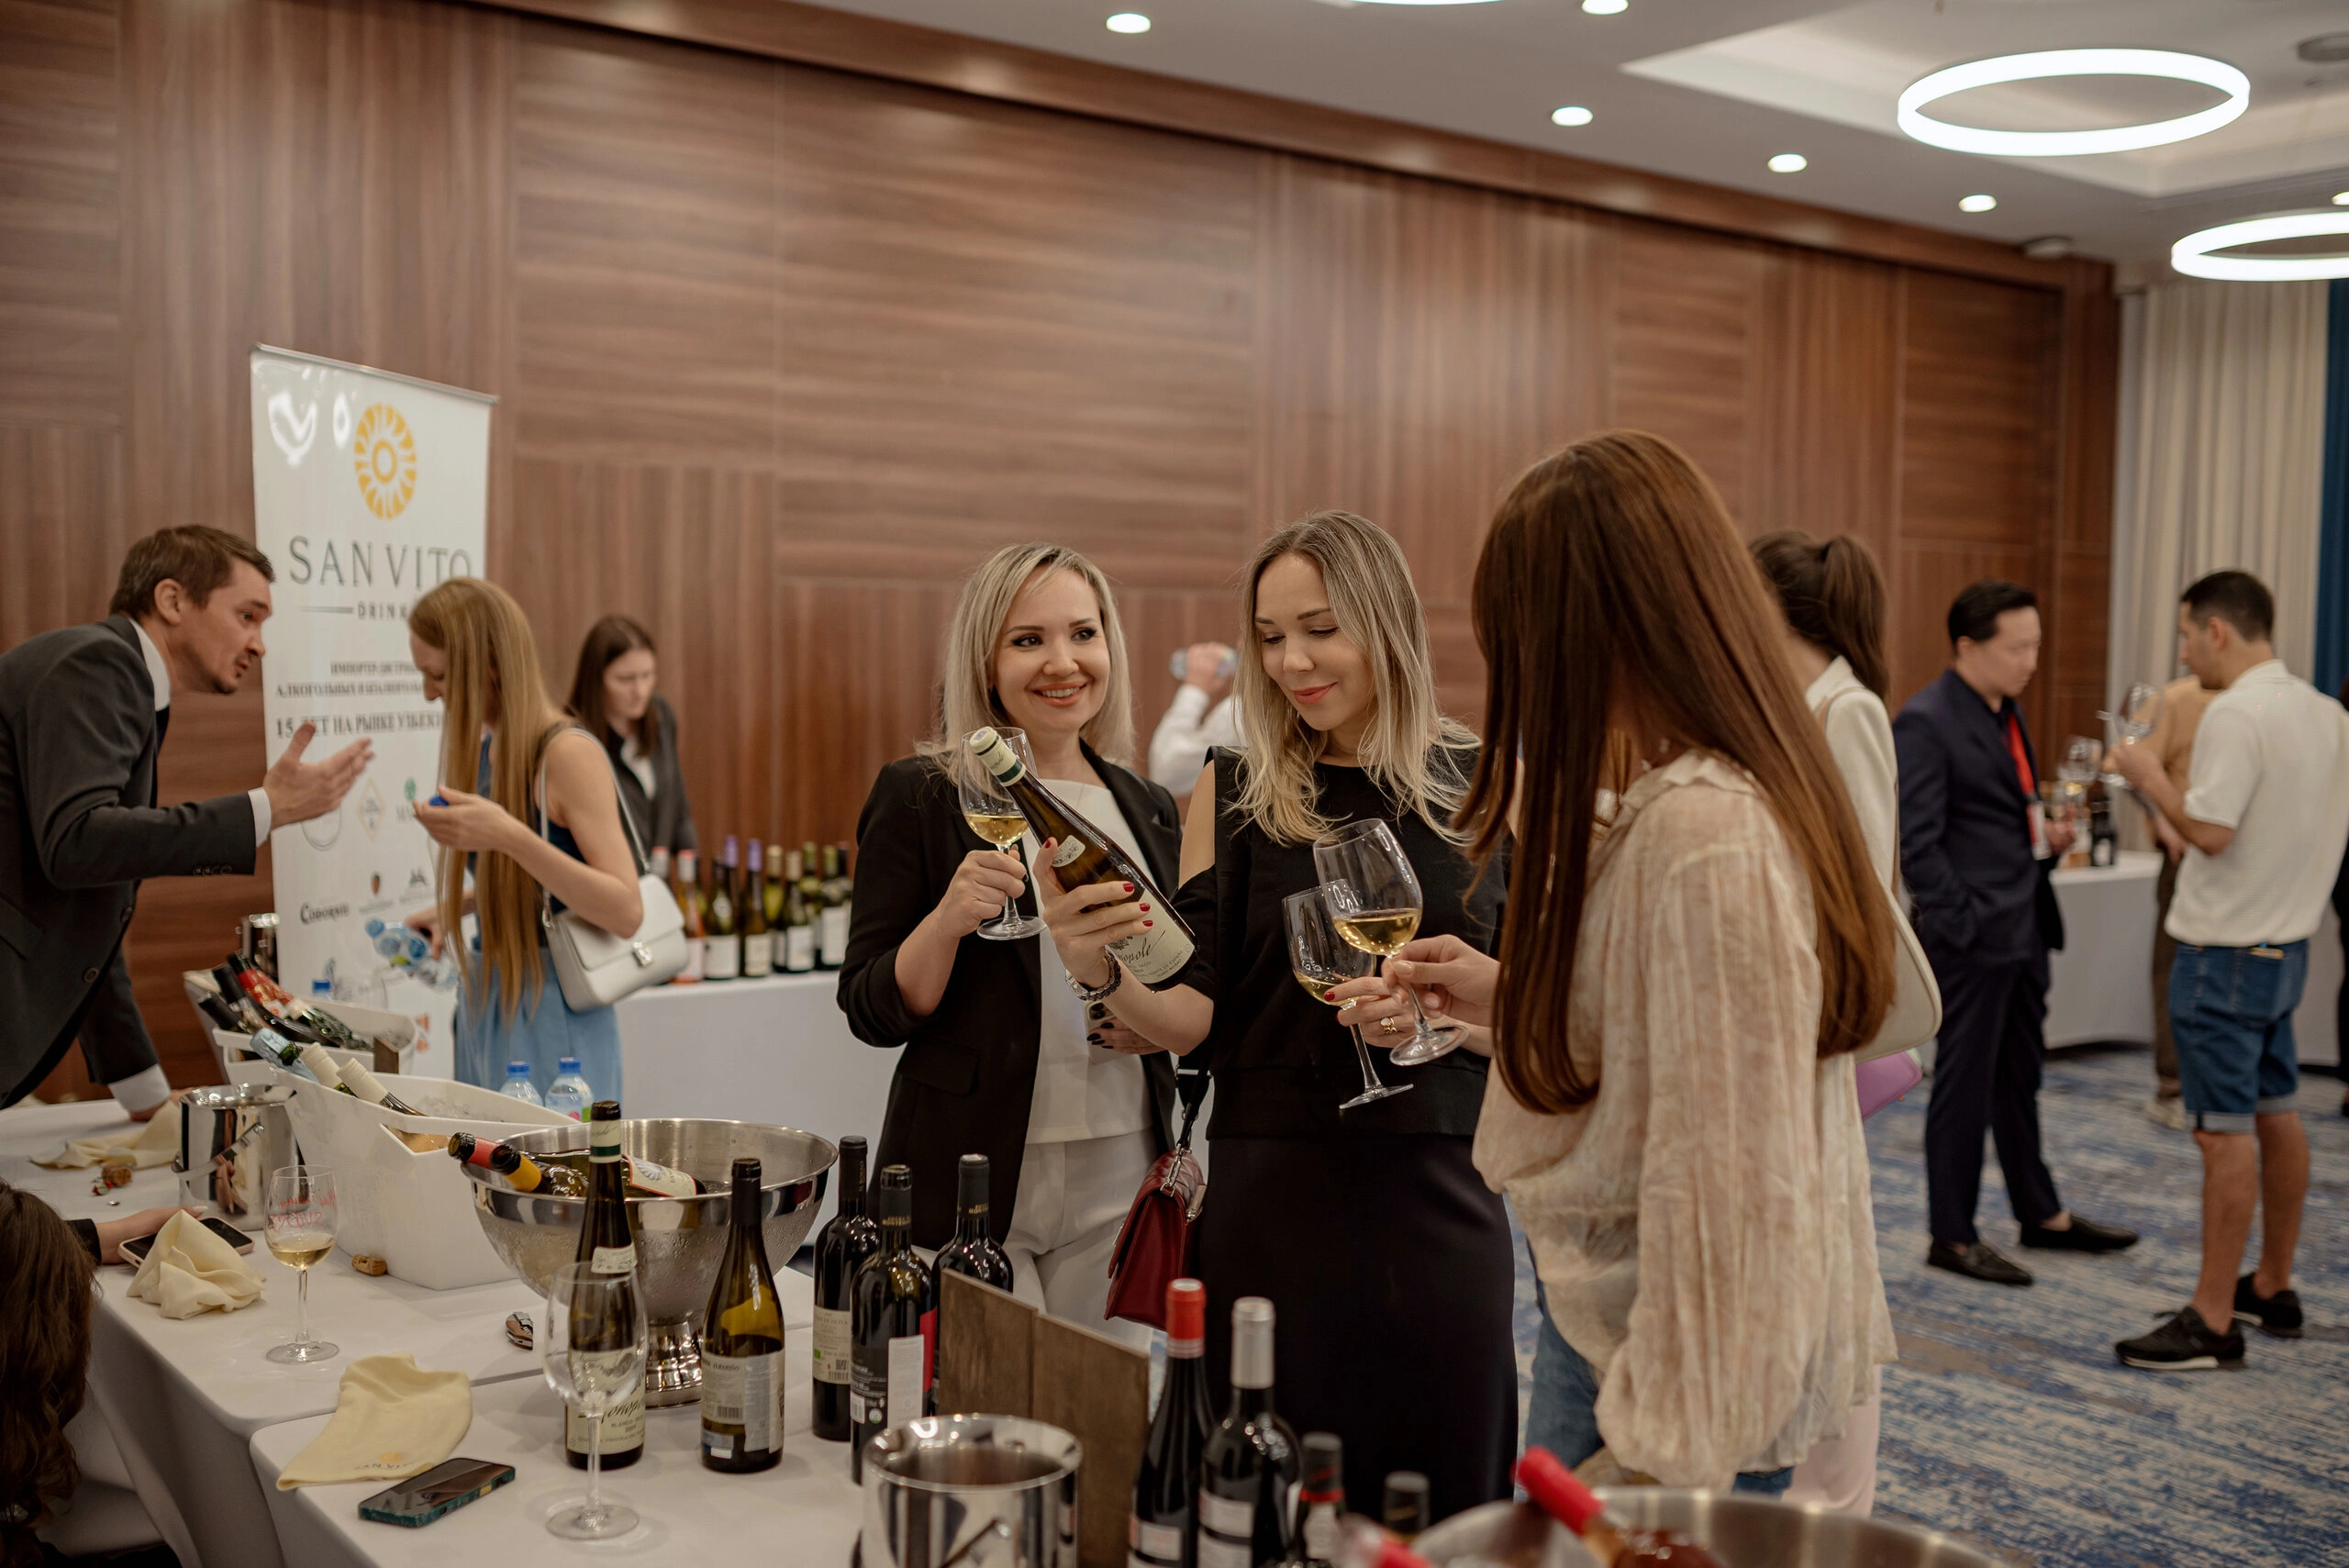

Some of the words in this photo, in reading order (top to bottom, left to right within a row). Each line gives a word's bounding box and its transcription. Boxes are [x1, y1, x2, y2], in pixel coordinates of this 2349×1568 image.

[288, 535, 373, 588] SAN
[385, 543, 471, 592] VITO
[358, 601, 409, 620] DRINK
[276, 717, 294, 738] 15
[333, 714, 353, 734] НА
